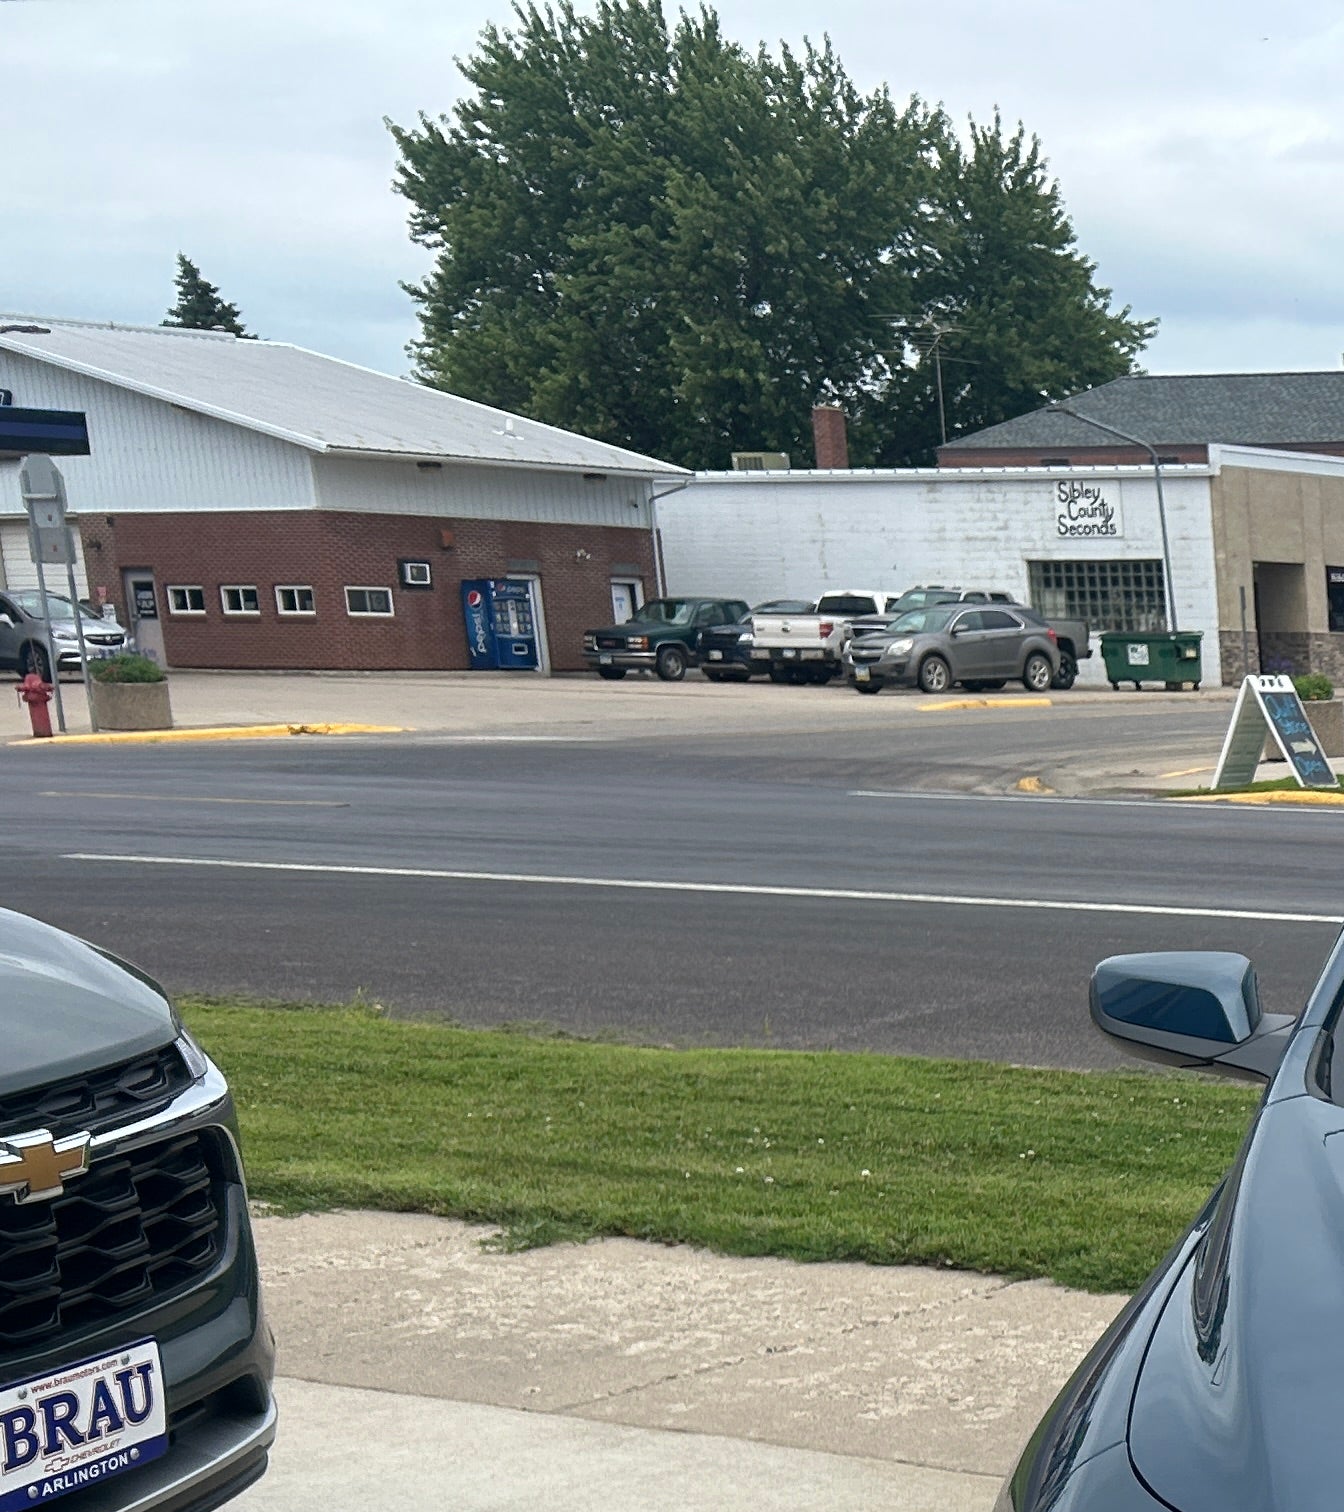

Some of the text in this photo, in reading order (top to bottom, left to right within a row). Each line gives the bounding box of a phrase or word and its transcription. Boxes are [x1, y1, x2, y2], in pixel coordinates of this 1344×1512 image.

[1058, 480, 1100, 506] Sibley
[1068, 498, 1114, 524] County
[1058, 514, 1117, 536] Seconds
[31, 1358, 119, 1394] www.braumotors.com
[0, 1360, 155, 1476] BRAU
[69, 1438, 121, 1463] CHEVROLET
[42, 1452, 128, 1497] ARLINGTON
